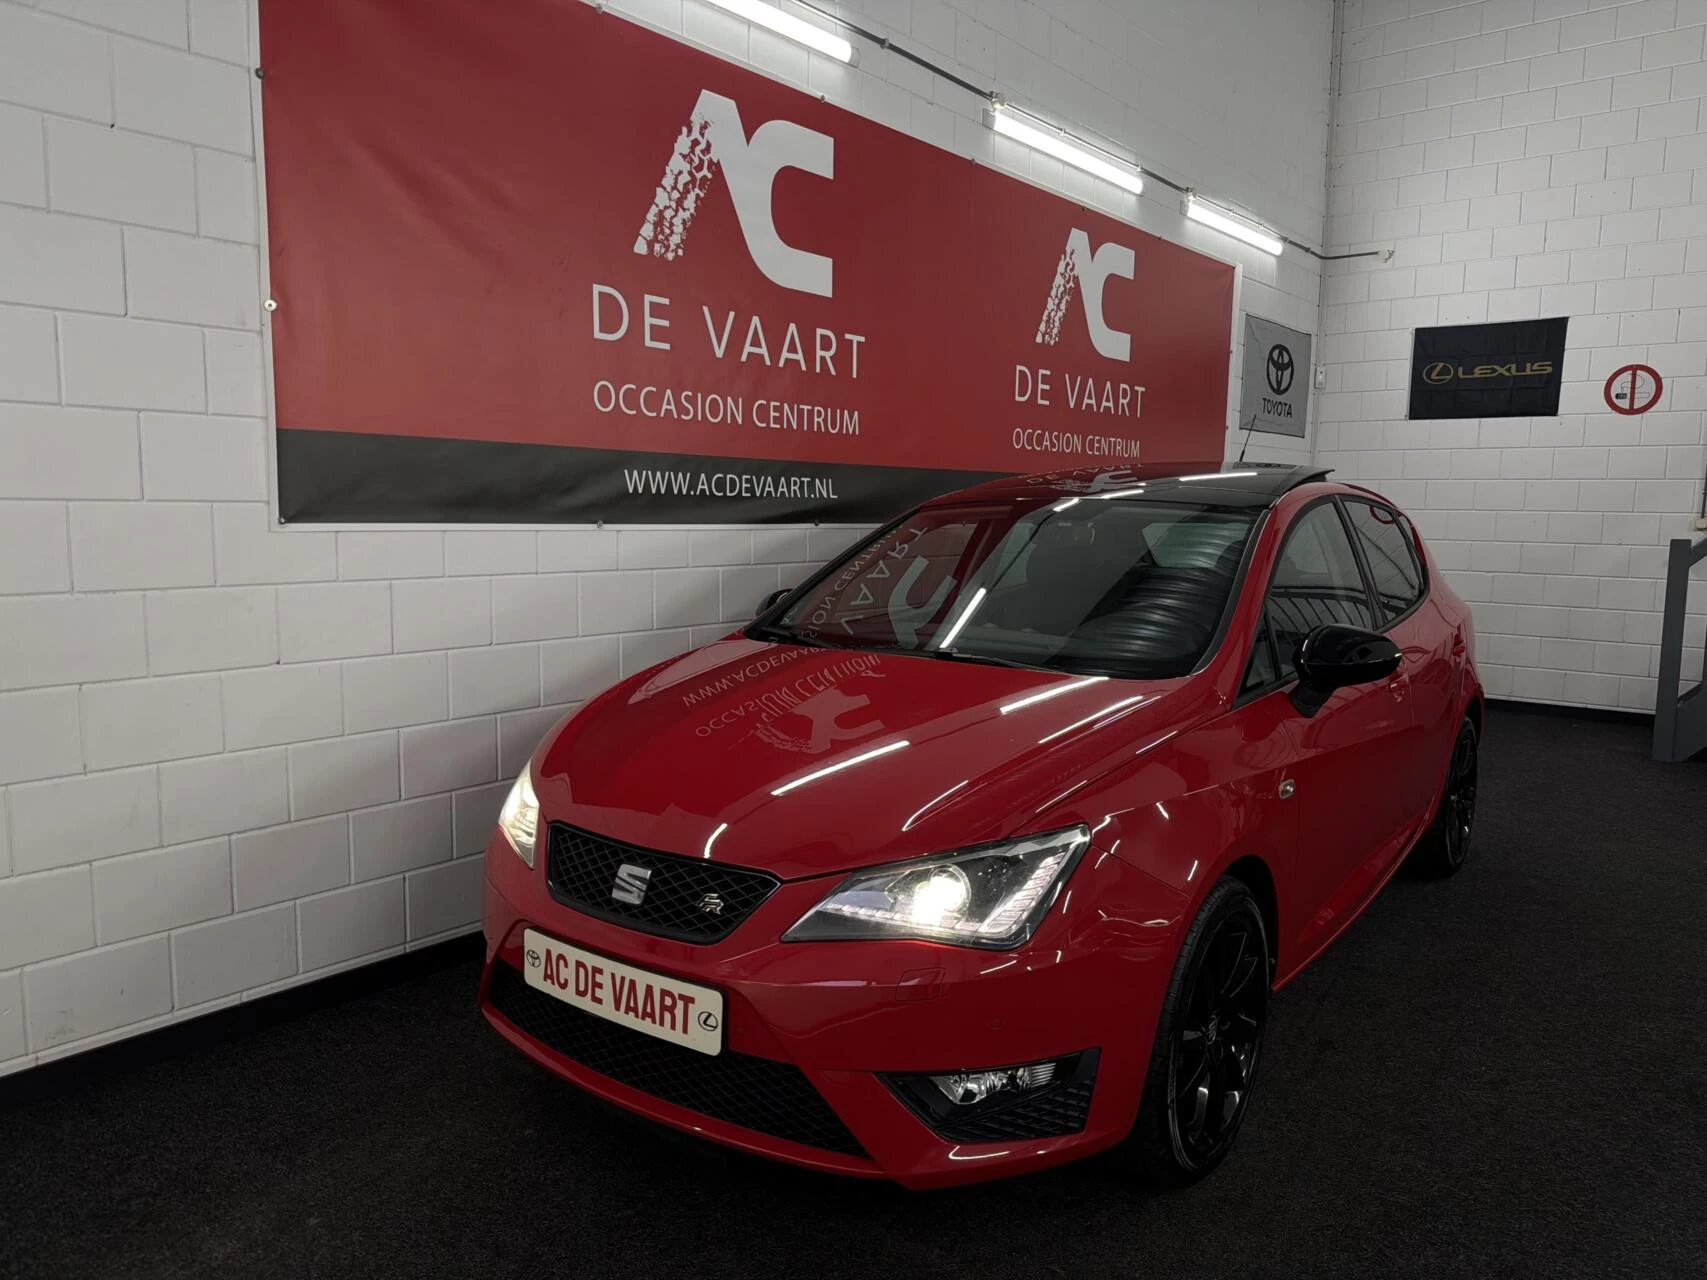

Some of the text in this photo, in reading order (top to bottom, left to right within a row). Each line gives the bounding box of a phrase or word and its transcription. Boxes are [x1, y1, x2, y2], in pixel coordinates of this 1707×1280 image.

[592, 283, 866, 378] DE VAART
[1458, 361, 1552, 378] LEXUS
[593, 380, 859, 435] OCCASION CENTRUM
[1015, 364, 1146, 418] DE VAART
[1262, 397, 1292, 419] TOYOTA
[1012, 427, 1140, 458] OCCASION CENTRUM
[624, 469, 838, 499] WWW.ACDEVAART.NL
[543, 948, 569, 990] AC
[575, 962, 604, 1005] DE
[610, 972, 696, 1036] VAART
